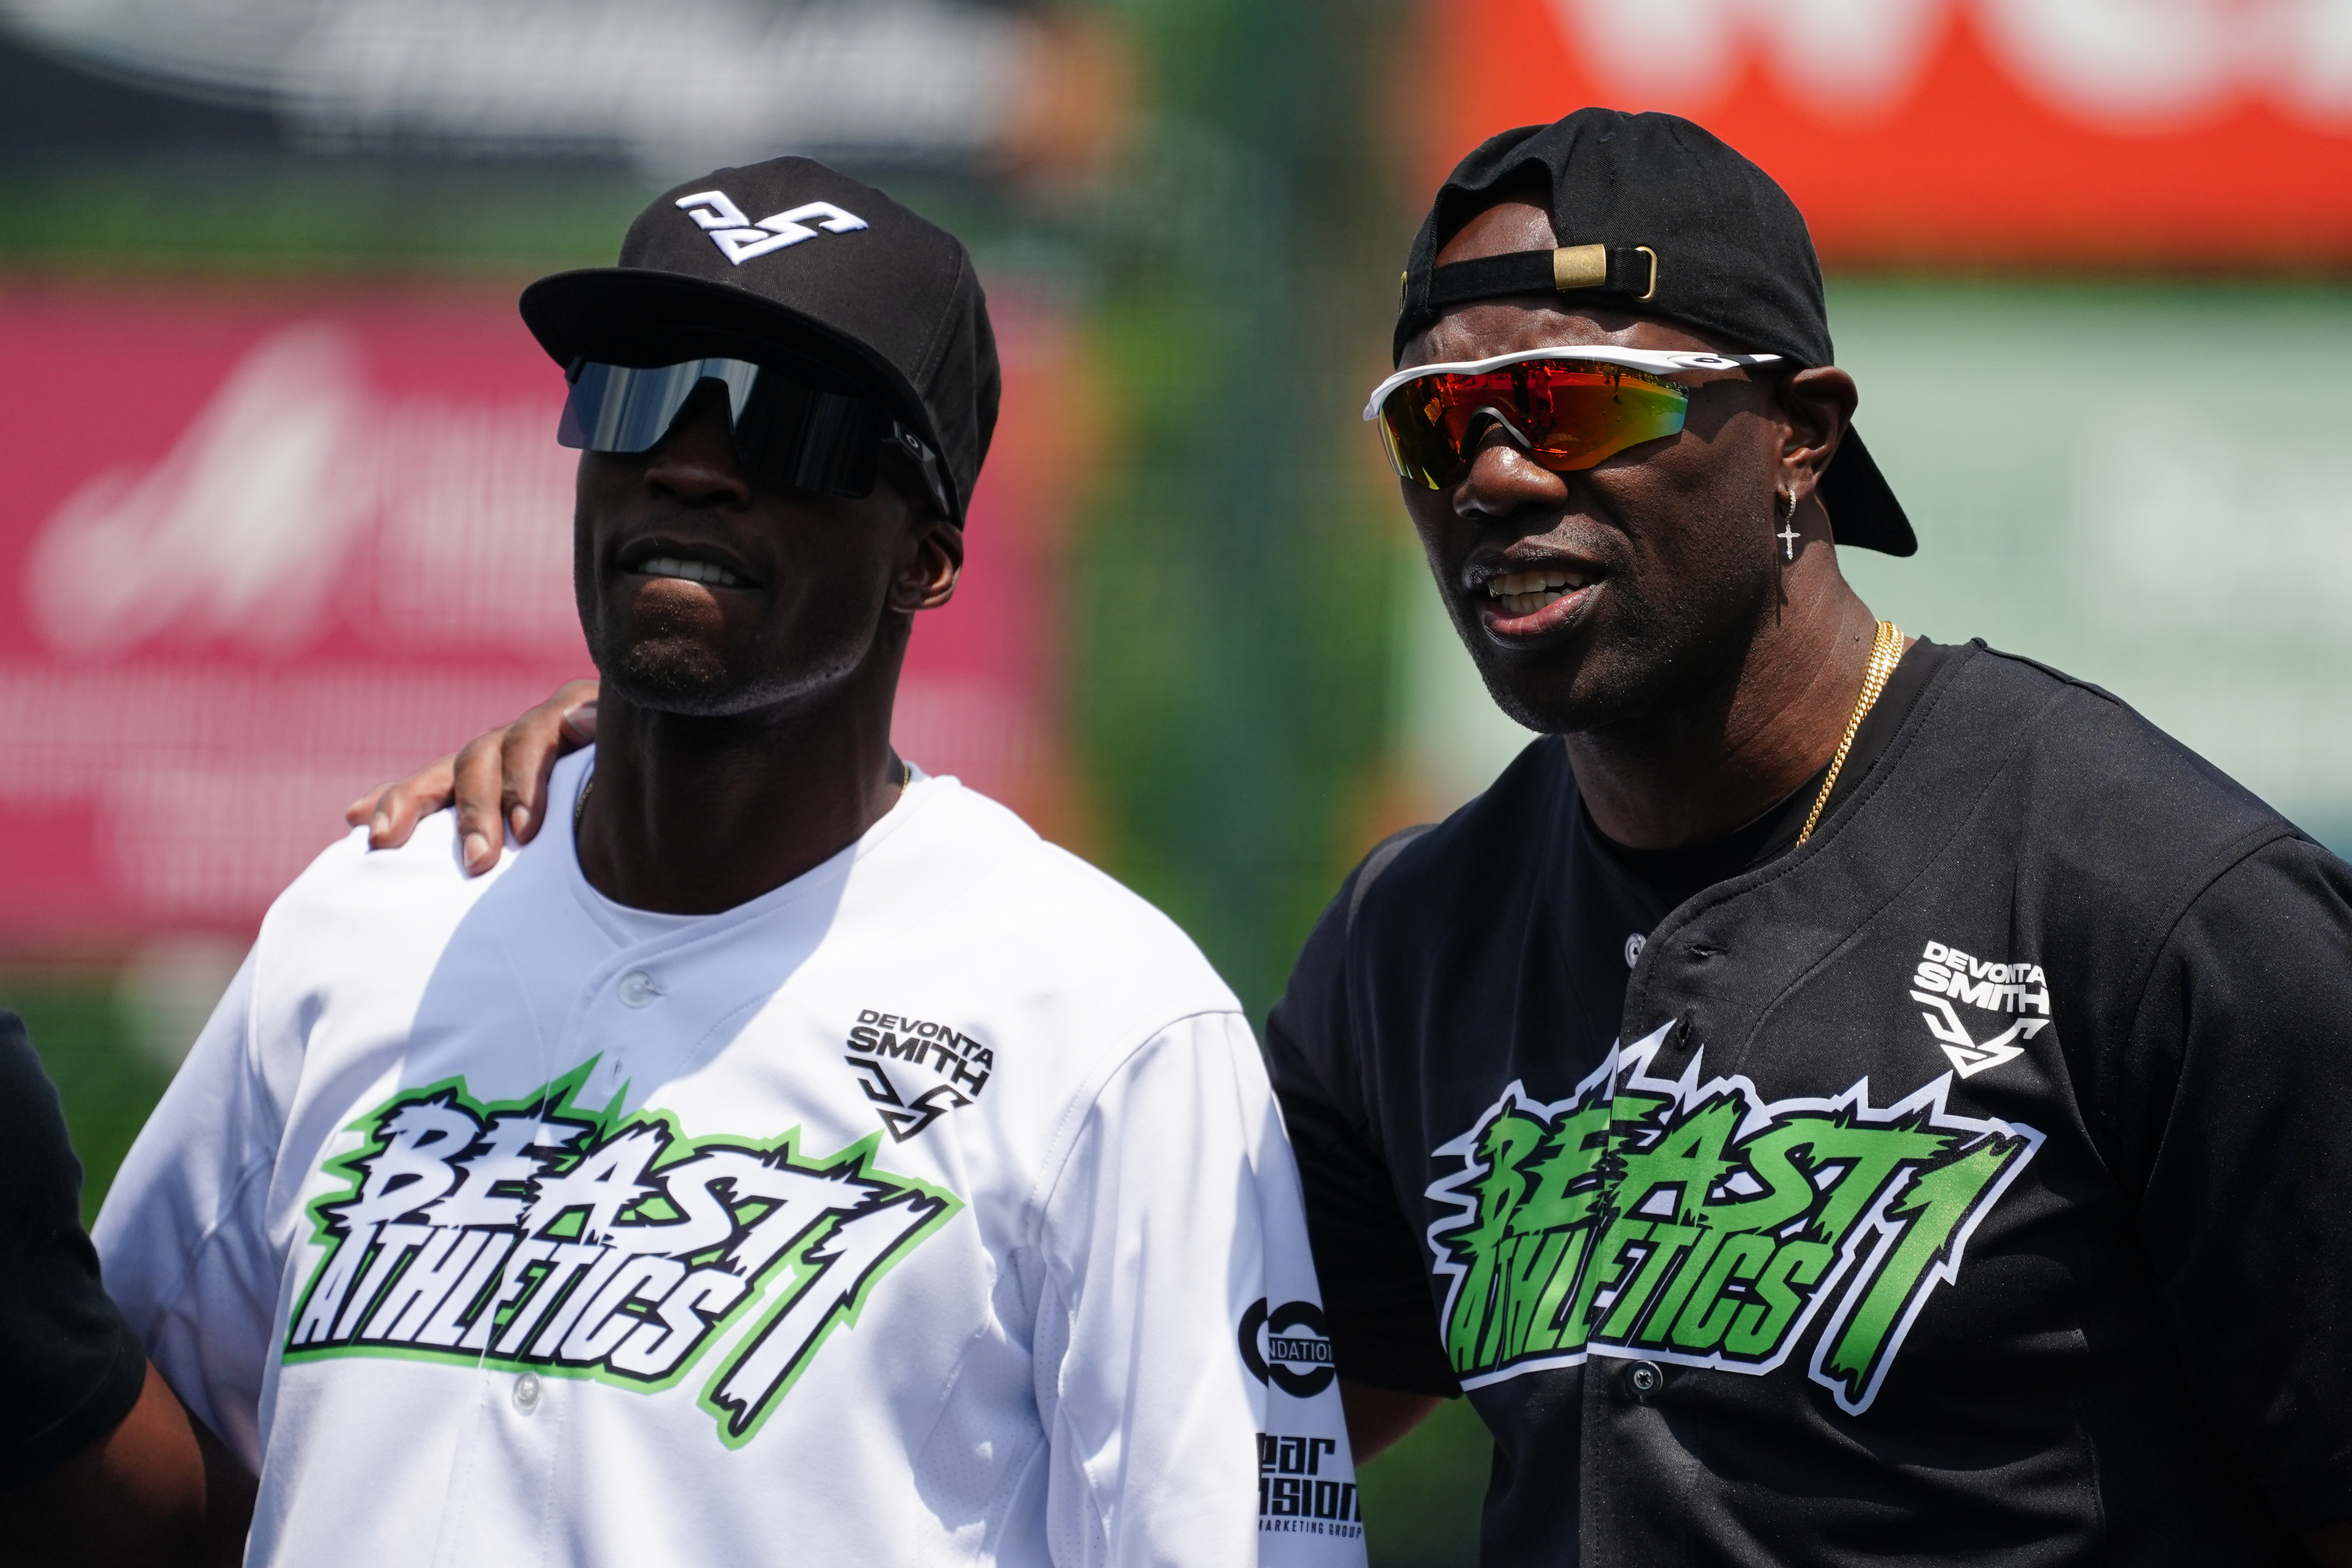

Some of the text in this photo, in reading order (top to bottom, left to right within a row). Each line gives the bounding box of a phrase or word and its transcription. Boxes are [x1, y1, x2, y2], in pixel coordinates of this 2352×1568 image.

[1913, 961, 2050, 1015] SMITH
[1922, 940, 2047, 989] DEVONTA
[846, 1026, 990, 1097] SMITH
[855, 1009, 994, 1071] DEVONTA
[333, 1091, 883, 1275] BEAST
[1468, 1090, 1961, 1247] BEAST
[288, 1219, 750, 1379] ATHLETICS
[1447, 1220, 1837, 1374] ATHLETICS
[1329, 1524, 1362, 1539] GROUP
